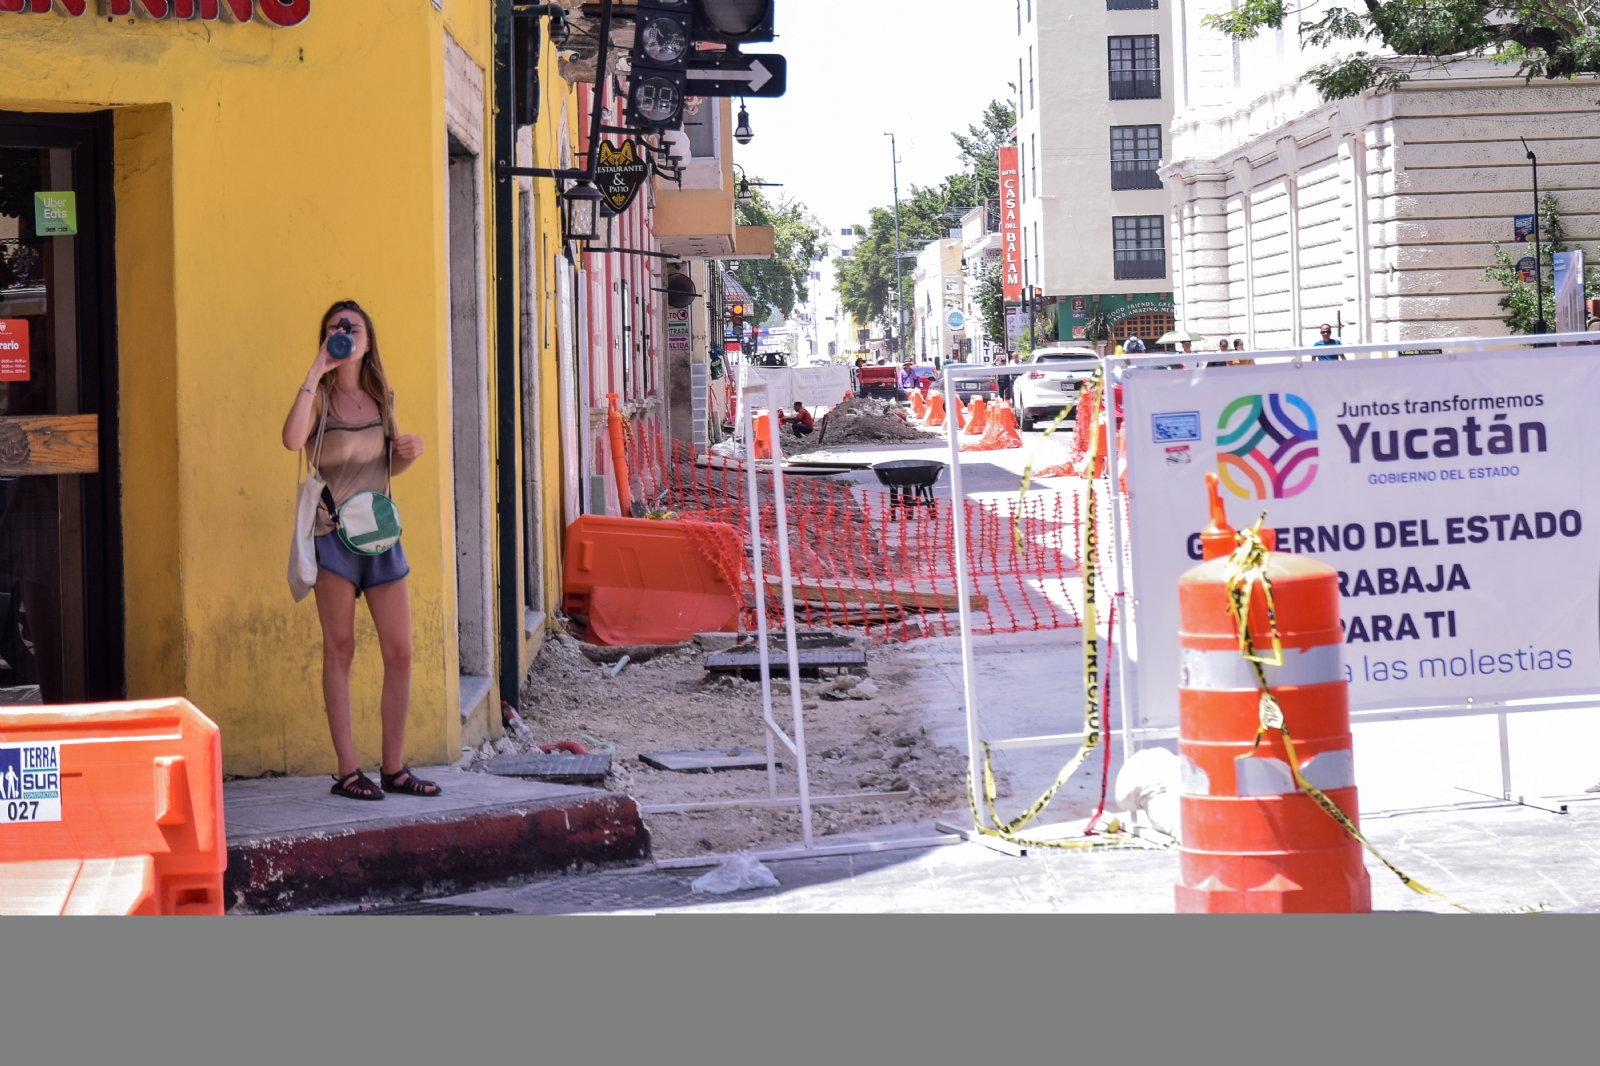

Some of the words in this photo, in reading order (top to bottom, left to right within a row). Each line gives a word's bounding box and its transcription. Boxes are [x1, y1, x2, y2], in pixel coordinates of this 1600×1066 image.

[594, 165, 643, 173] ESTAURANTE
[613, 172, 625, 185] &
[43, 198, 66, 208] Uber
[1004, 179, 1017, 220] CASA
[44, 209, 67, 218] Eats
[1006, 232, 1019, 285] BALAM
[1106, 307, 1125, 319] GOOD
[1128, 307, 1158, 315] AMAZING
[1337, 402, 1400, 418] Juntos
[1404, 394, 1544, 414] transformemos
[1337, 413, 1548, 464] Yucatán
[1368, 471, 1437, 485] GOBIERNO
[1440, 469, 1465, 480] DEL
[1469, 465, 1520, 479] ESTADO
[1374, 519, 1440, 550] DEL
[1446, 509, 1582, 545] ESTADO
[1341, 613, 1420, 644] ARA
[1424, 610, 1457, 639] TI
[1364, 655, 1409, 682] las
[1419, 645, 1573, 678] molestias
[23, 746, 57, 768] TERRA
[23, 773, 58, 790] SUR
[24, 791, 58, 799] CONSTRUCTORA
[7, 801, 39, 821] 027
